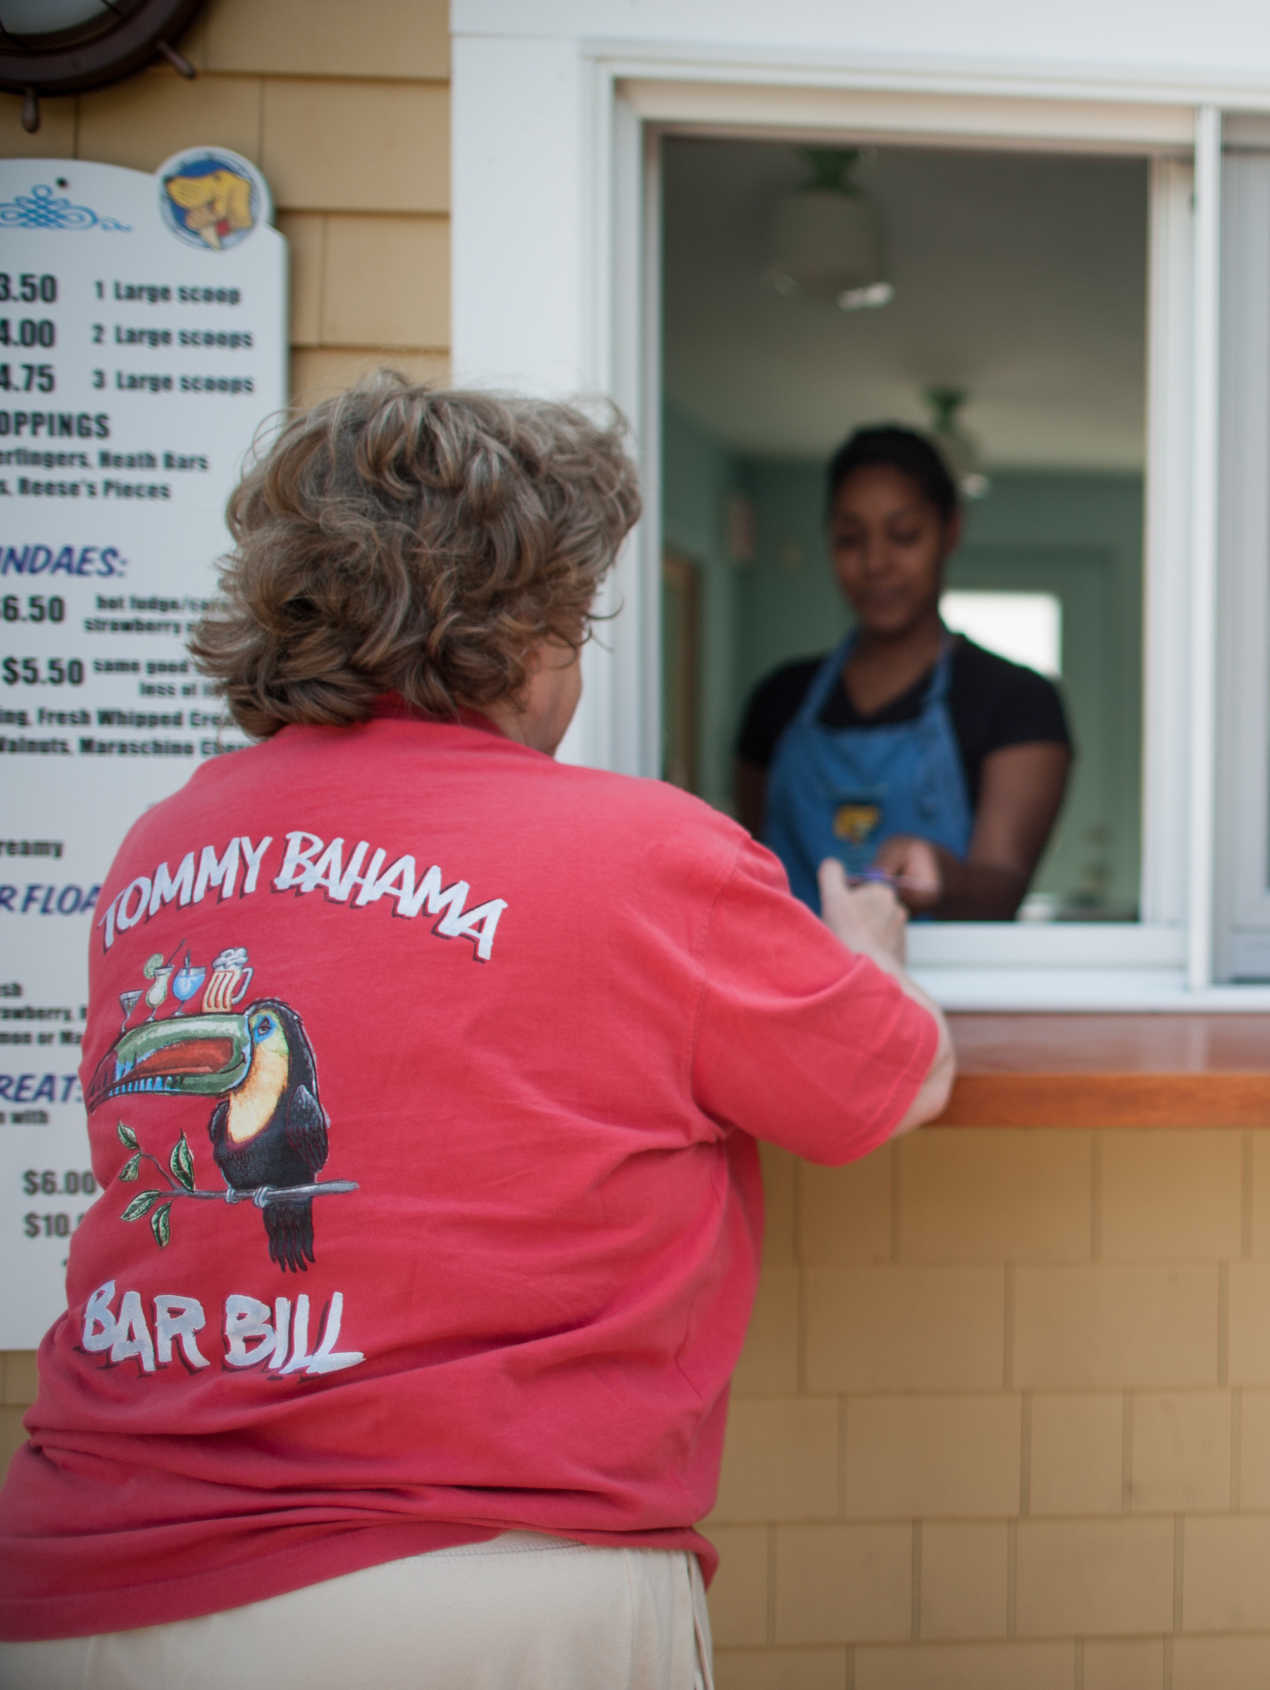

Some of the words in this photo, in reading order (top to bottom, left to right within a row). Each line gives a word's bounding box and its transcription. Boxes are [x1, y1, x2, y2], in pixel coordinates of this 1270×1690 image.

[95, 281, 104, 299] 1
[114, 281, 171, 304] Large
[178, 286, 240, 305] scoop
[93, 324, 104, 343] 2
[115, 325, 171, 347] Large
[179, 330, 253, 348] scoops
[93, 370, 105, 389] 3
[116, 371, 172, 392] Large
[180, 376, 254, 394] scoops
[99, 451, 156, 468] Heath
[163, 452, 208, 470] Bars
[18, 477, 97, 496] Reese's
[103, 480, 170, 498] Pieces
[0, 544, 127, 577] NDAES:
[0, 596, 65, 622] 6.50
[84, 617, 181, 634] strawberry
[2, 657, 84, 685] $5.50
[146, 660, 188, 674] good
[37, 707, 91, 725] Fresh
[97, 709, 183, 729] Whipped
[79, 737, 194, 755] Maraschino
[100, 836, 273, 948] TOMMY
[273, 831, 508, 961] BAHAMA
[23, 1169, 97, 1195] $6.00
[24, 1212, 86, 1238] $10.
[82, 1280, 210, 1372] BAR
[223, 1291, 365, 1375] BILL
